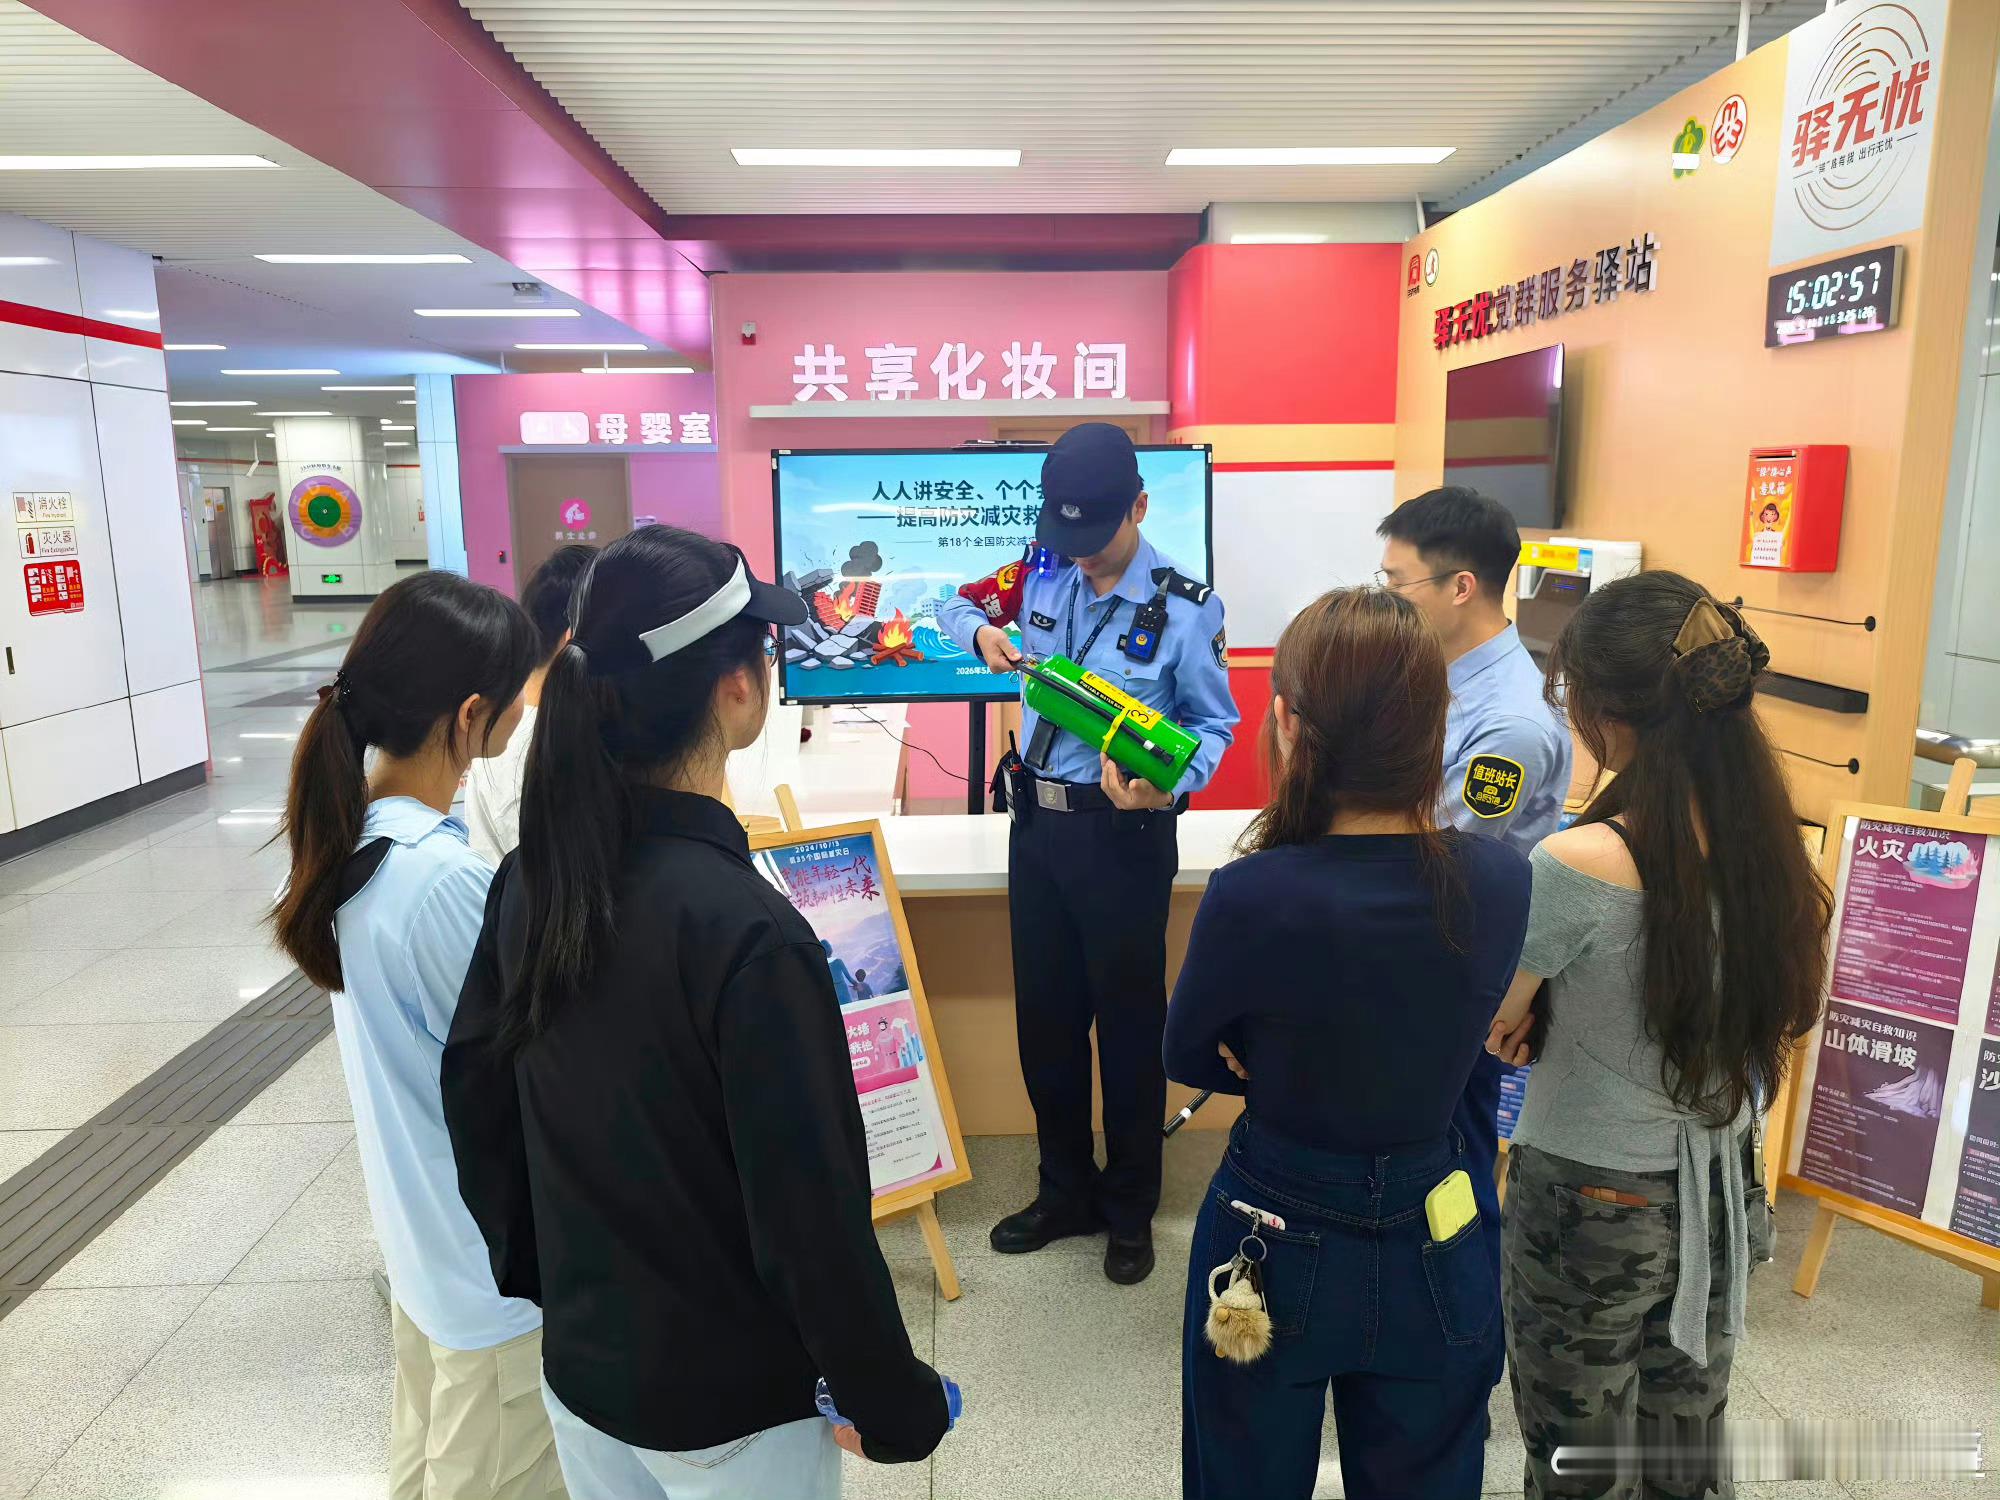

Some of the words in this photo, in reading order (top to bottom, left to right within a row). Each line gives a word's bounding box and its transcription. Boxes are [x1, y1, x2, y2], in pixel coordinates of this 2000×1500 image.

[1792, 60, 1930, 168] 驿无忧
[1858, 136, 1894, 161] 出行无忧
[1434, 232, 1660, 349] 驿无忧党群服务驿站
[1786, 261, 1881, 314] 15:02:57
[793, 341, 1127, 402] 共享化妆间
[595, 412, 712, 445] 母婴室
[38, 496, 68, 510] 消火栓
[41, 530, 72, 545] 灭火器
[1473, 764, 1517, 789] 值班站长
[1860, 820, 1950, 840] 防灾减灾自救知识
[795, 840, 840, 853] 2024/10/13
[1856, 835, 1904, 862] 火灾
[788, 874, 880, 909] 筑韧性未来
[1828, 1010, 1918, 1042] 防灾减灾自救知识
[1824, 1028, 1918, 1070] 山体滑坡
